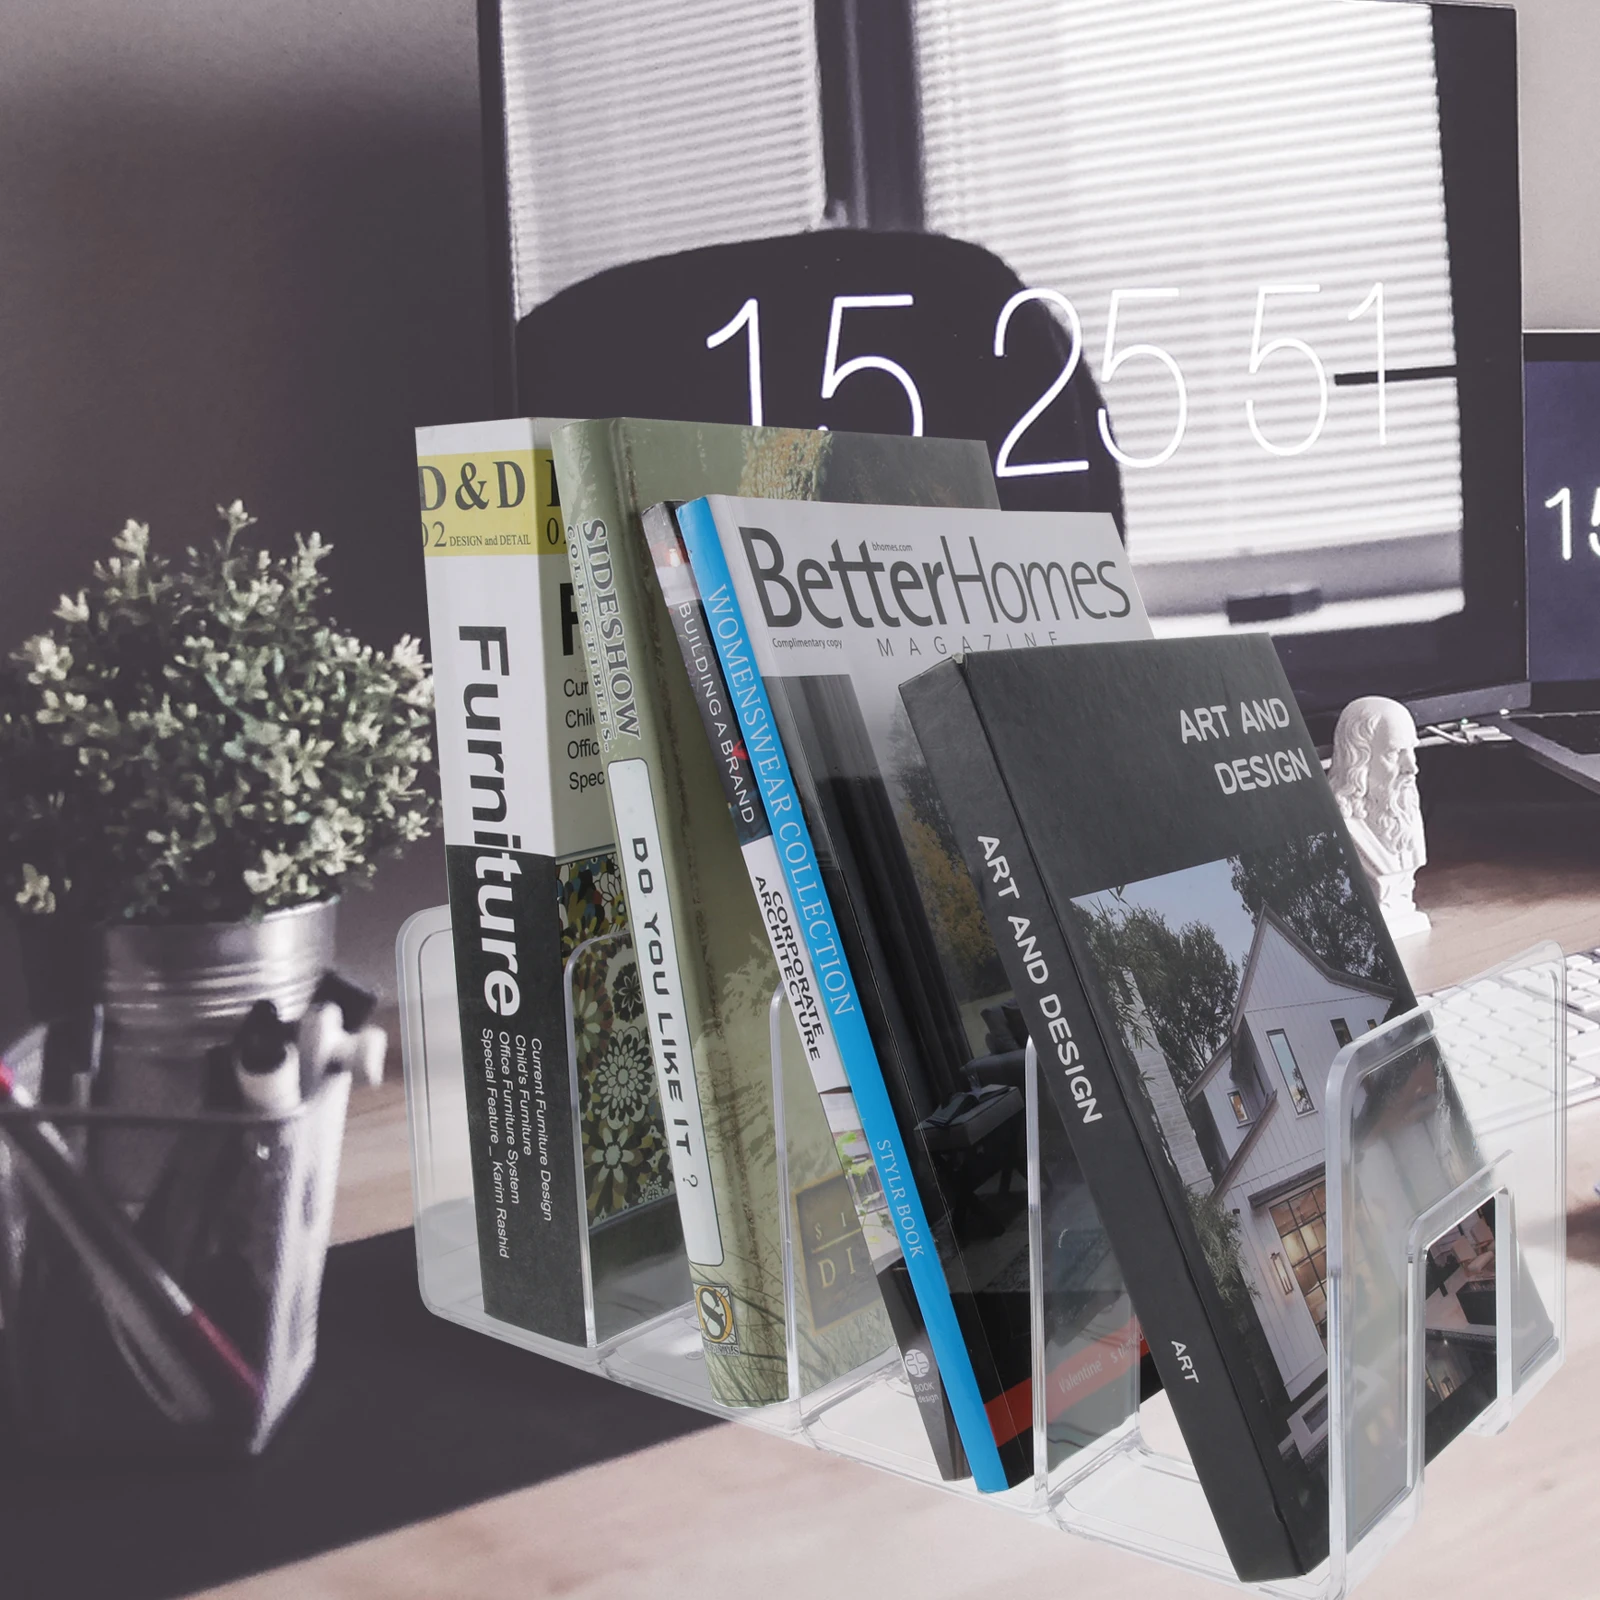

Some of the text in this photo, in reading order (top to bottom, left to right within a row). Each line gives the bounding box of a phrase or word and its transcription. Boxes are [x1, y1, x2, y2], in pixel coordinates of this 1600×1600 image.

[707, 282, 1388, 478] 15 25 51
[450, 536, 482, 547] DESIGN
[485, 535, 498, 545] and
[500, 535, 531, 546] DETAIL
[871, 541, 913, 552] bhomes.com
[1545, 487, 1600, 561] 1
[582, 518, 641, 740] SIDESHOW
[772, 638, 842, 649] Complimentary copy
[566, 709, 595, 728] Chil
[679, 601, 755, 823] BUILDING A BRAND
[1180, 698, 1290, 744] ART AND
[708, 584, 855, 1016] WOMENSWEAR COLLECTION
[1214, 748, 1312, 795] DESIGN
[458, 625, 522, 1017] Furniture
[632, 837, 654, 895] DO
[644, 912, 670, 996] YOU
[658, 1012, 683, 1102] LIKE
[673, 1118, 692, 1157] IT
[755, 876, 821, 1061] ARCHITECTURE
[772, 890, 825, 1036] CORPORATE
[977, 835, 1103, 1124] ART AND DESIGN
[481, 1028, 496, 1084] Special
[515, 1034, 532, 1156] Child's Furniture
[486, 1086, 500, 1144] Feature
[499, 1030, 520, 1204] Office Furniture System
[531, 1037, 552, 1222] Current Furniture Design
[492, 1162, 504, 1204] Karim
[876, 1139, 925, 1258] STYLR BOOK
[496, 1206, 510, 1259] Rashid
[914, 1382, 935, 1393] BOOK
[1171, 1340, 1200, 1384] ART
